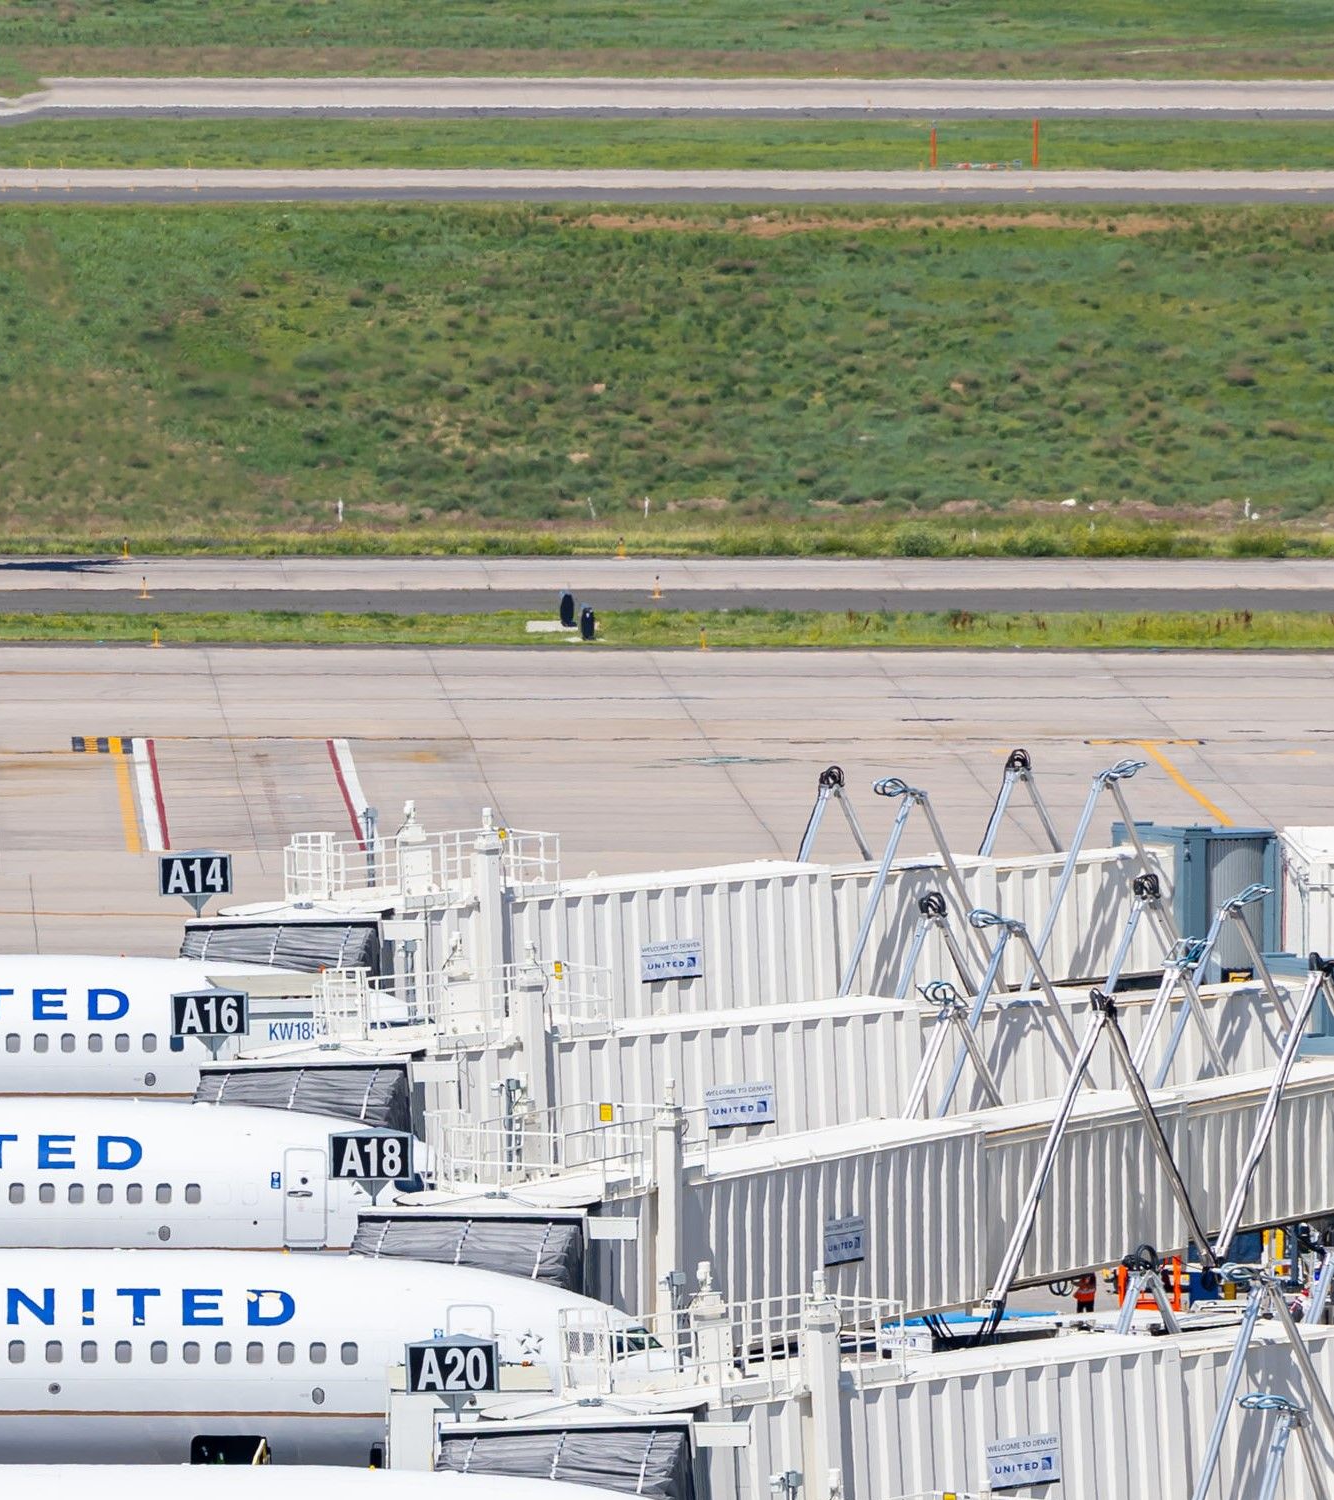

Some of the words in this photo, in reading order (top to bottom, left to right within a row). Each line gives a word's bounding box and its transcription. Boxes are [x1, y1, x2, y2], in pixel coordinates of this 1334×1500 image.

[167, 859, 224, 893] A14
[647, 961, 685, 970] UNITED
[181, 997, 239, 1034] A16
[269, 1022, 315, 1040] KW18
[712, 1105, 754, 1115] UNITED
[340, 1138, 401, 1177] A18
[417, 1347, 488, 1391] A20
[987, 1441, 1021, 1453] WELCOME
[1023, 1440, 1031, 1448] TO
[994, 1462, 1039, 1474] UNITED
